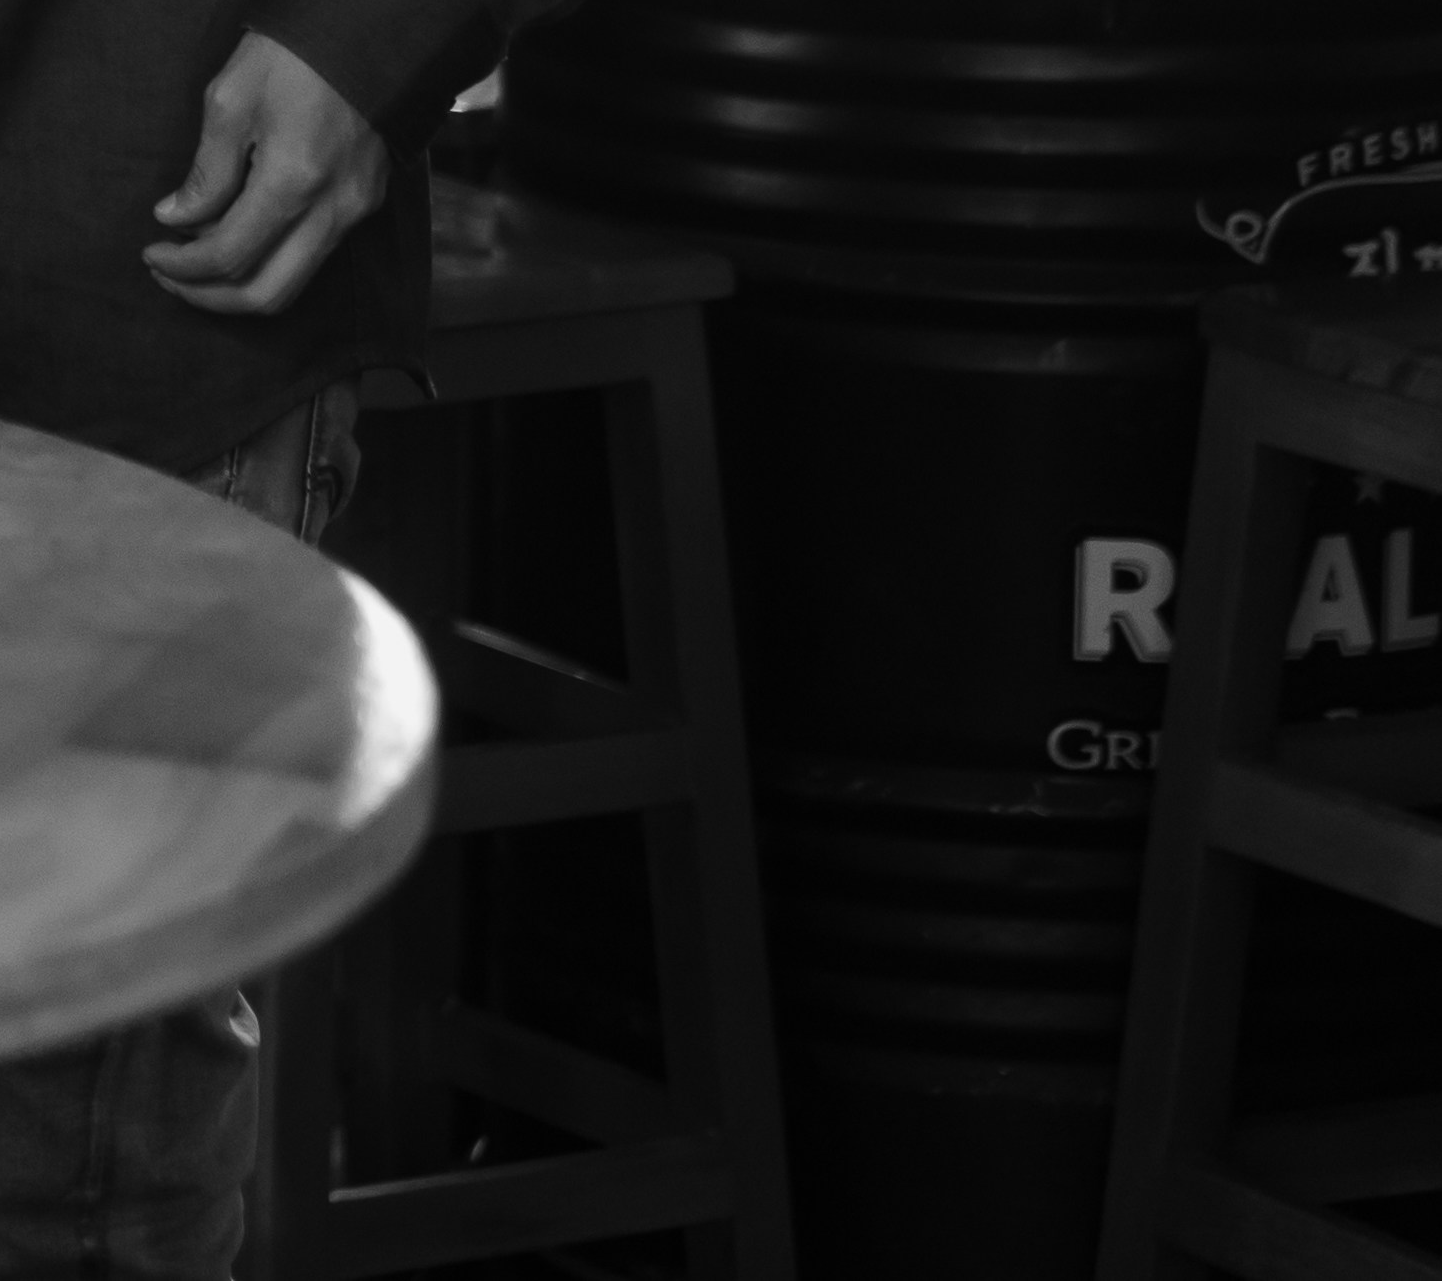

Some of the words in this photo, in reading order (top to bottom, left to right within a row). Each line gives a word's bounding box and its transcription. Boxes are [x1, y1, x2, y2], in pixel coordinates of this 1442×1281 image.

[1296, 120, 1440, 187] FRESH
[1072, 526, 1442, 663] RAL
[1046, 718, 1163, 770] GRI
